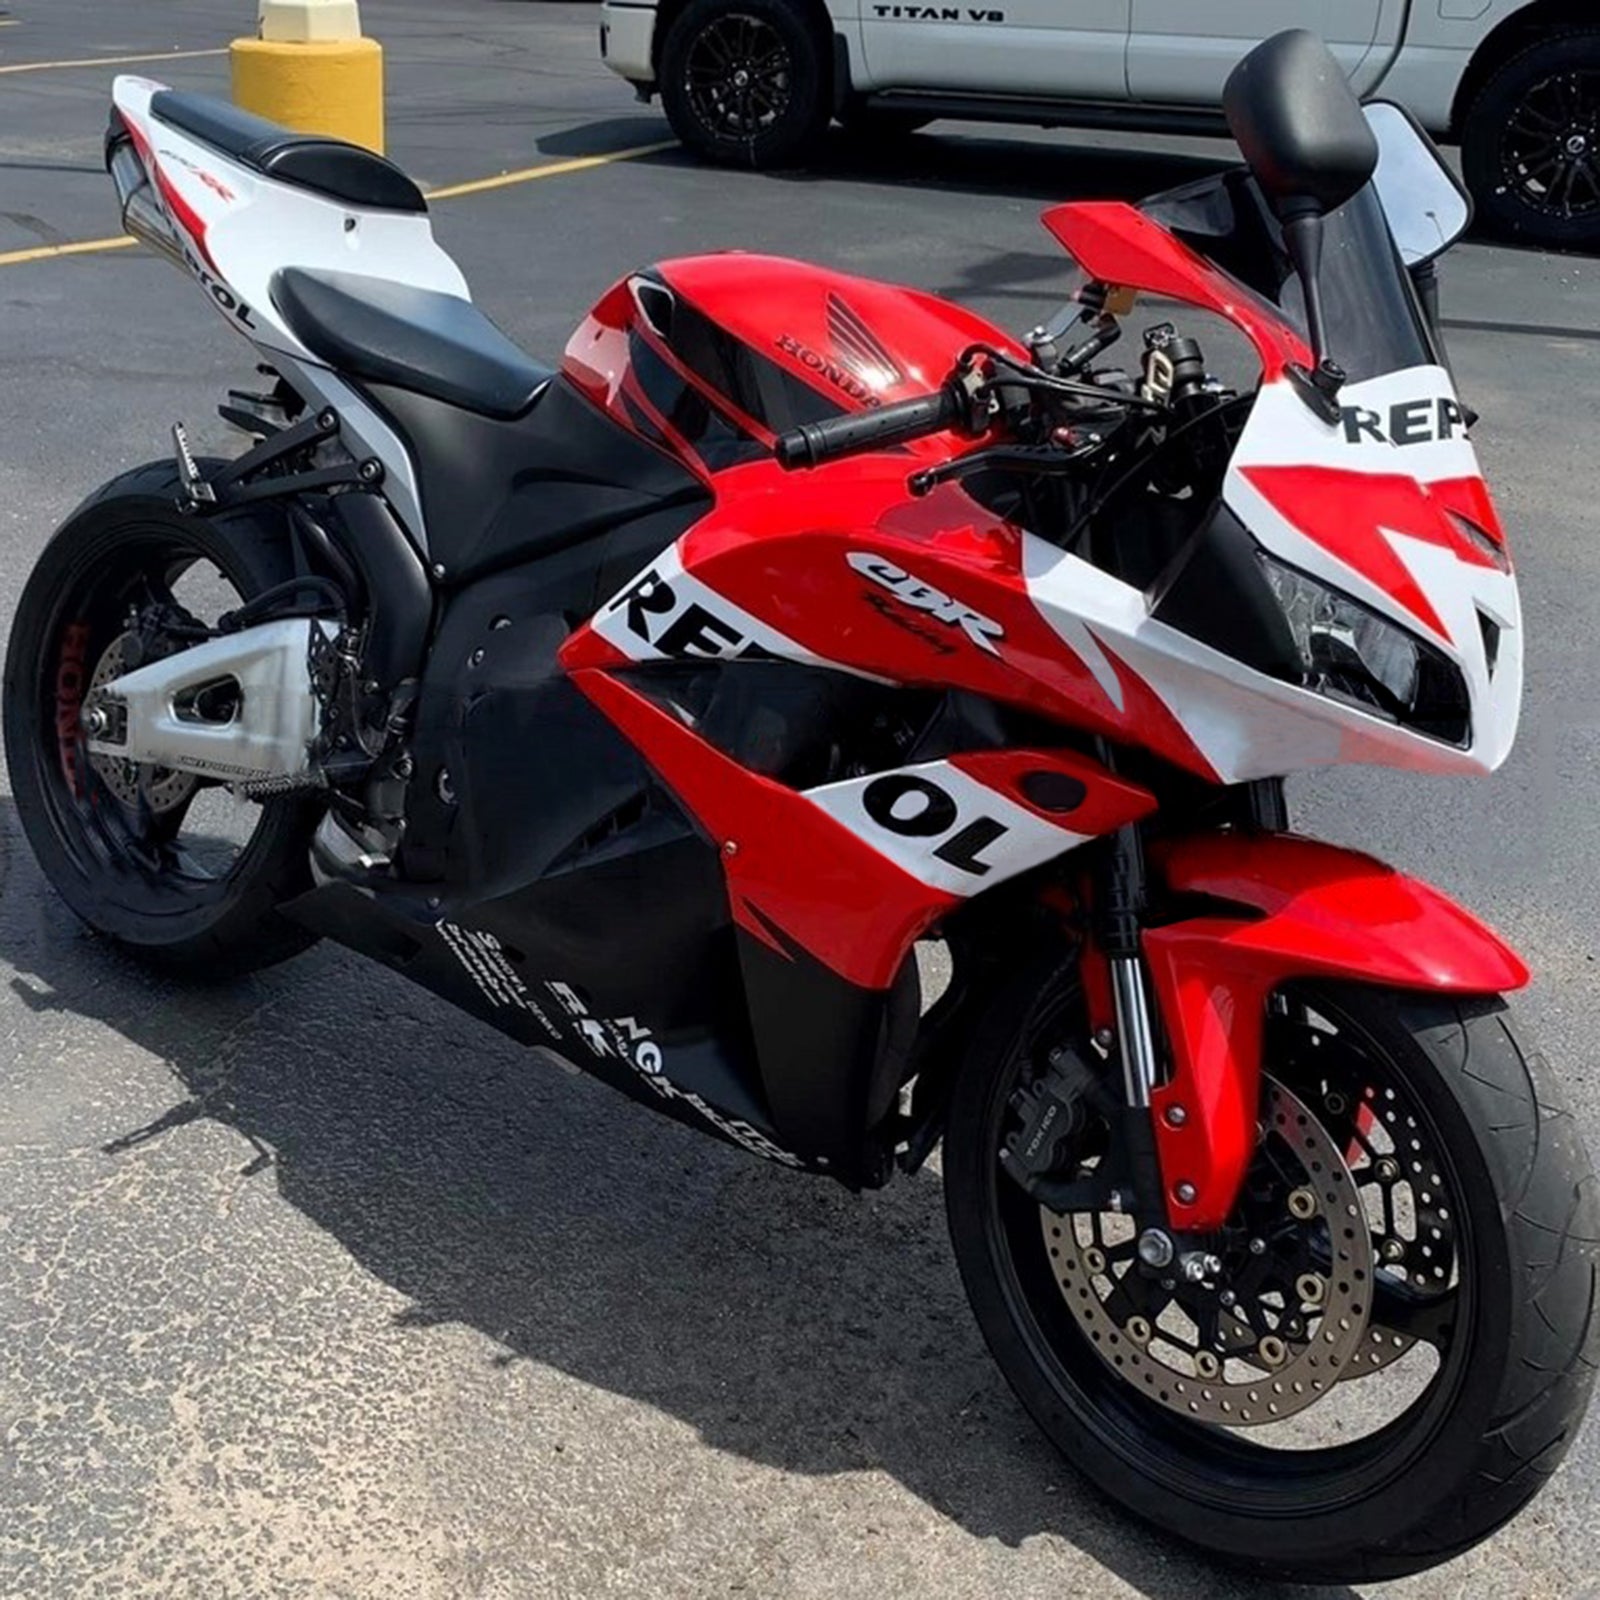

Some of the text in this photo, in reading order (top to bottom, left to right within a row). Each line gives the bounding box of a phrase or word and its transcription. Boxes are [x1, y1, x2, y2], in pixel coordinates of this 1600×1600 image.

[873, 5, 1004, 22] TITAN V8
[1341, 398, 1471, 447] REP
[846, 552, 1004, 658] CBR
[862, 774, 1009, 877] OL
[1025, 1105, 1058, 1158] TOKICO
